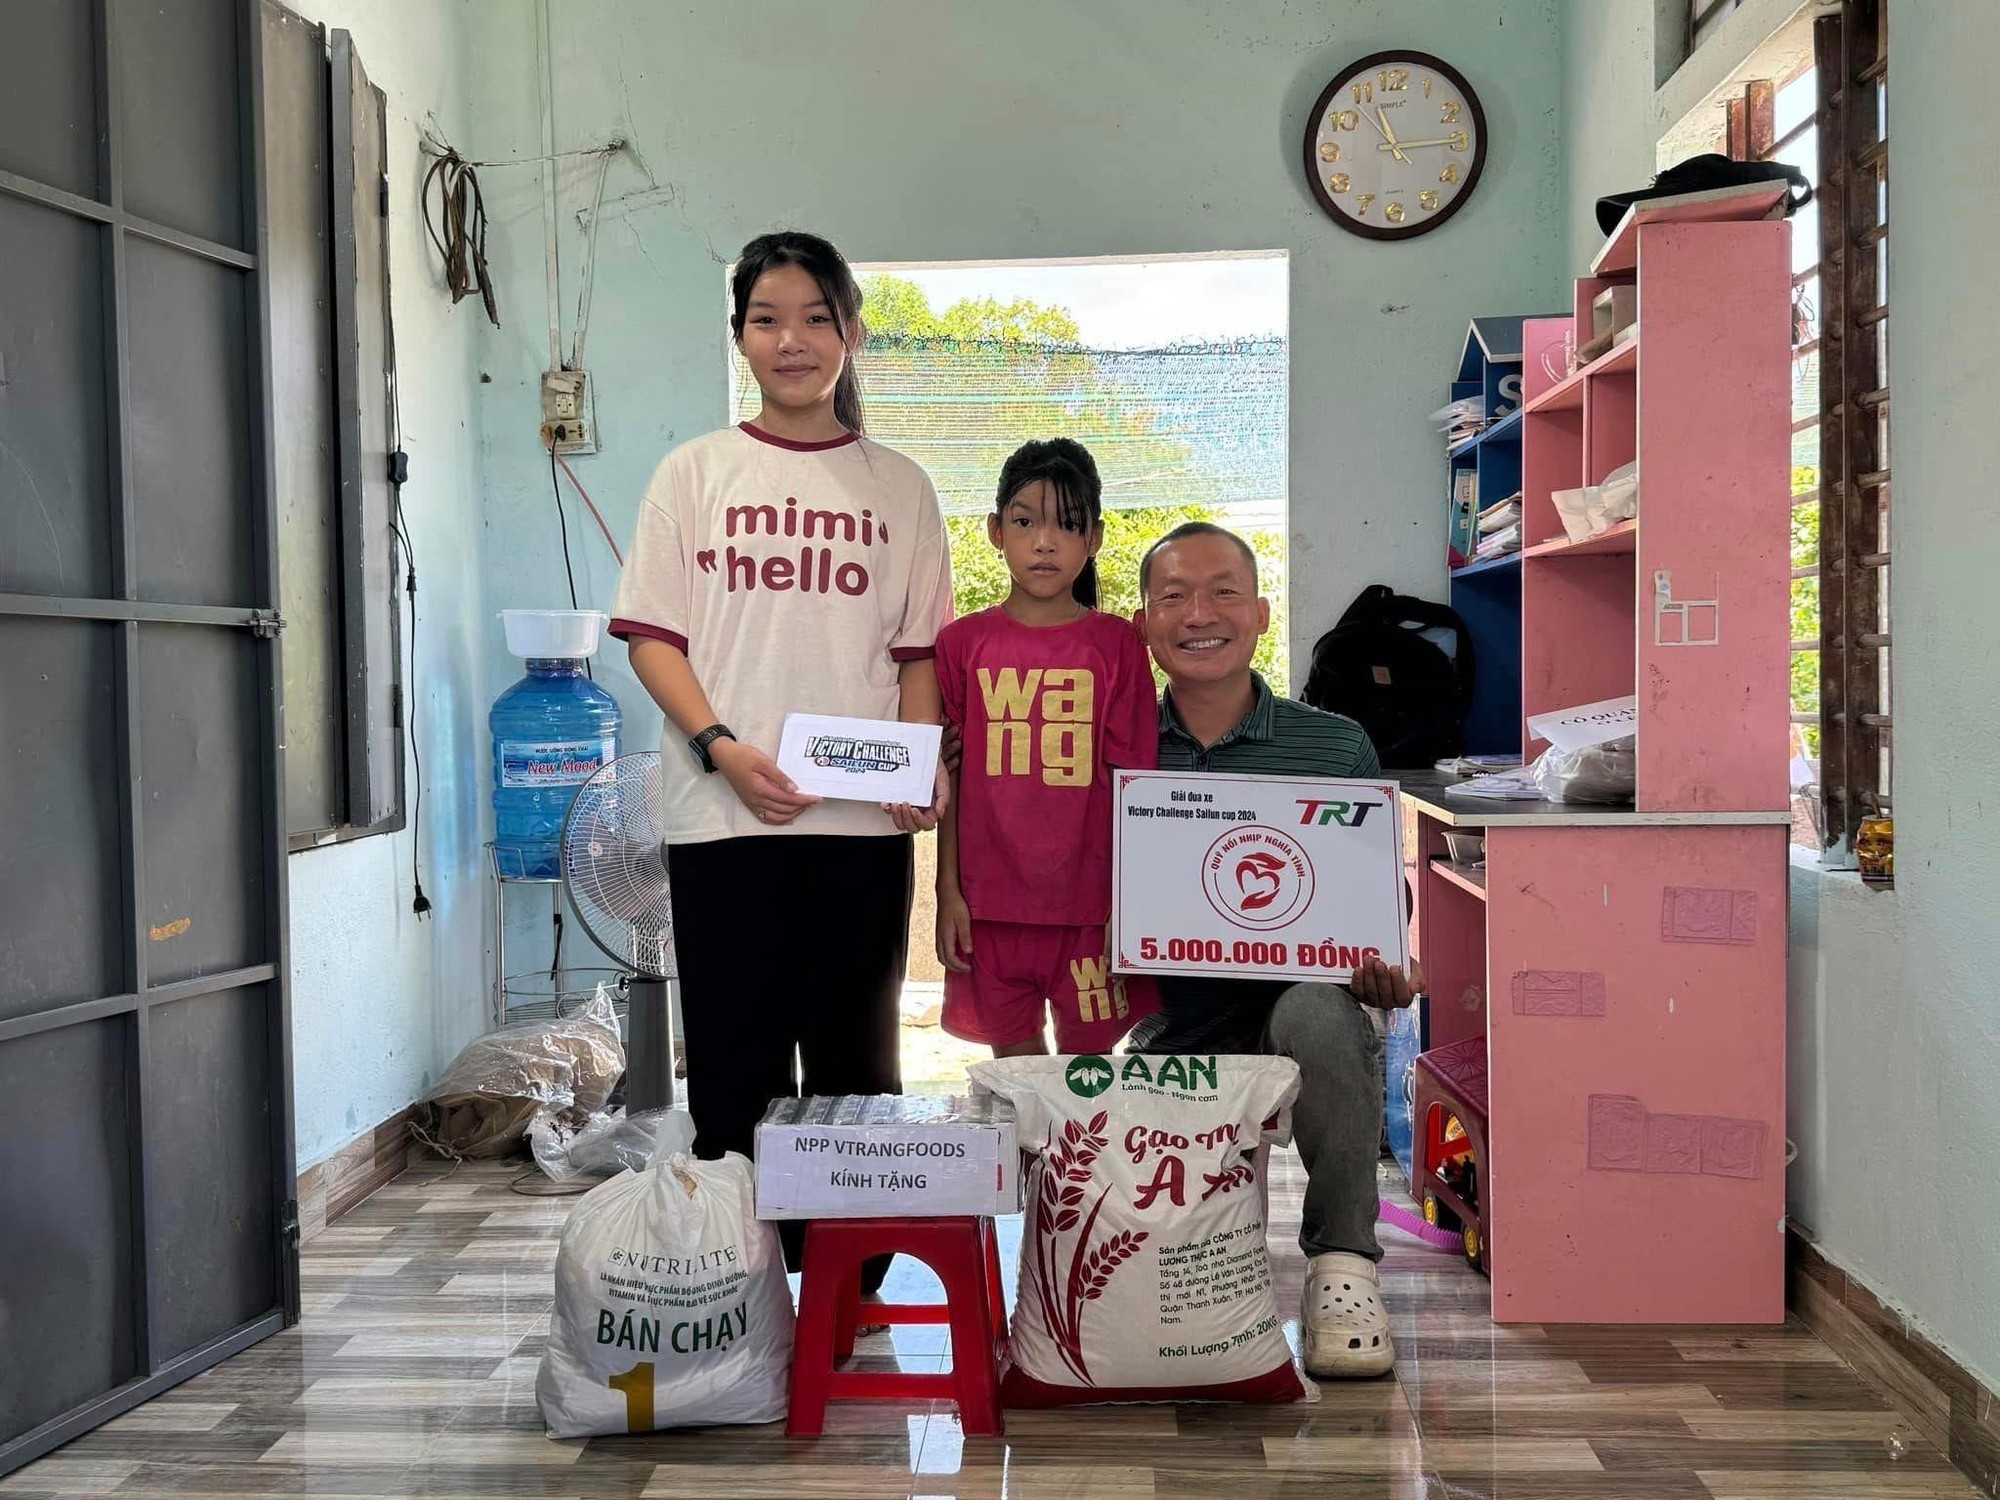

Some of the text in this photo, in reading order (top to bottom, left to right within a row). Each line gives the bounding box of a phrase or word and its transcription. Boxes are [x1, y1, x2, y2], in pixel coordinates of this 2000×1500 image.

[1376, 69, 1408, 92] 12
[1421, 77, 1433, 99] 1
[1352, 82, 1373, 104] 11
[1329, 110, 1359, 132] 10
[1440, 102, 1460, 124] 2
[1320, 142, 1341, 163] 9
[1449, 131, 1469, 153] 3
[1329, 172, 1351, 194] 8
[1439, 164, 1460, 185] 4
[1356, 193, 1375, 216] 7
[1419, 189, 1440, 211] 5
[1385, 202, 1406, 224] 6
[852, 740, 911, 767] CHALLENGE
[527, 757, 599, 775] New Mood
[830, 758, 898, 772] SAILUN CUP
[1170, 789, 1214, 803] Giải đua xe
[1127, 805, 1257, 822] Victory Challenge Sailun cup 2024
[1295, 799, 1383, 828] TRT
[1221, 837, 1238, 853] NỐI
[1239, 834, 1262, 844] NHỊP
[1290, 855, 1305, 878] TÌNH
[1140, 937, 1287, 966] 5.000.000
[795, 1136, 966, 1158] NPP VTRANGFOODS
[1124, 1126, 1190, 1164] Gạo
[830, 1168, 927, 1192] KÍNH TẶNG
[1132, 1154, 1187, 1211] A
[1158, 1245, 1175, 1255] Sản
[1212, 1231, 1234, 1243] CÔNG
[1234, 1229, 1244, 1238] TY
[1209, 1249, 1216, 1257] A
[1216, 1245, 1227, 1255] AN
[623, 1244, 738, 1276] NUTRIITE
[1226, 1249, 1253, 1265] Diamond
[608, 1287, 636, 1301] VITAMIN
[1159, 1279, 1171, 1290] Số
[1173, 1279, 1183, 1288] 48
[1159, 1303, 1184, 1314] Quận
[1186, 1299, 1211, 1311] Thanh
[596, 1301, 749, 1354] BÁN CHẠY
[1160, 1316, 1183, 1325] Nam.
[1159, 1345, 1188, 1358] Khối
[1190, 1340, 1230, 1356] Lượng
[1256, 1314, 1279, 1336] 20KG
[608, 1361, 656, 1433] 1
